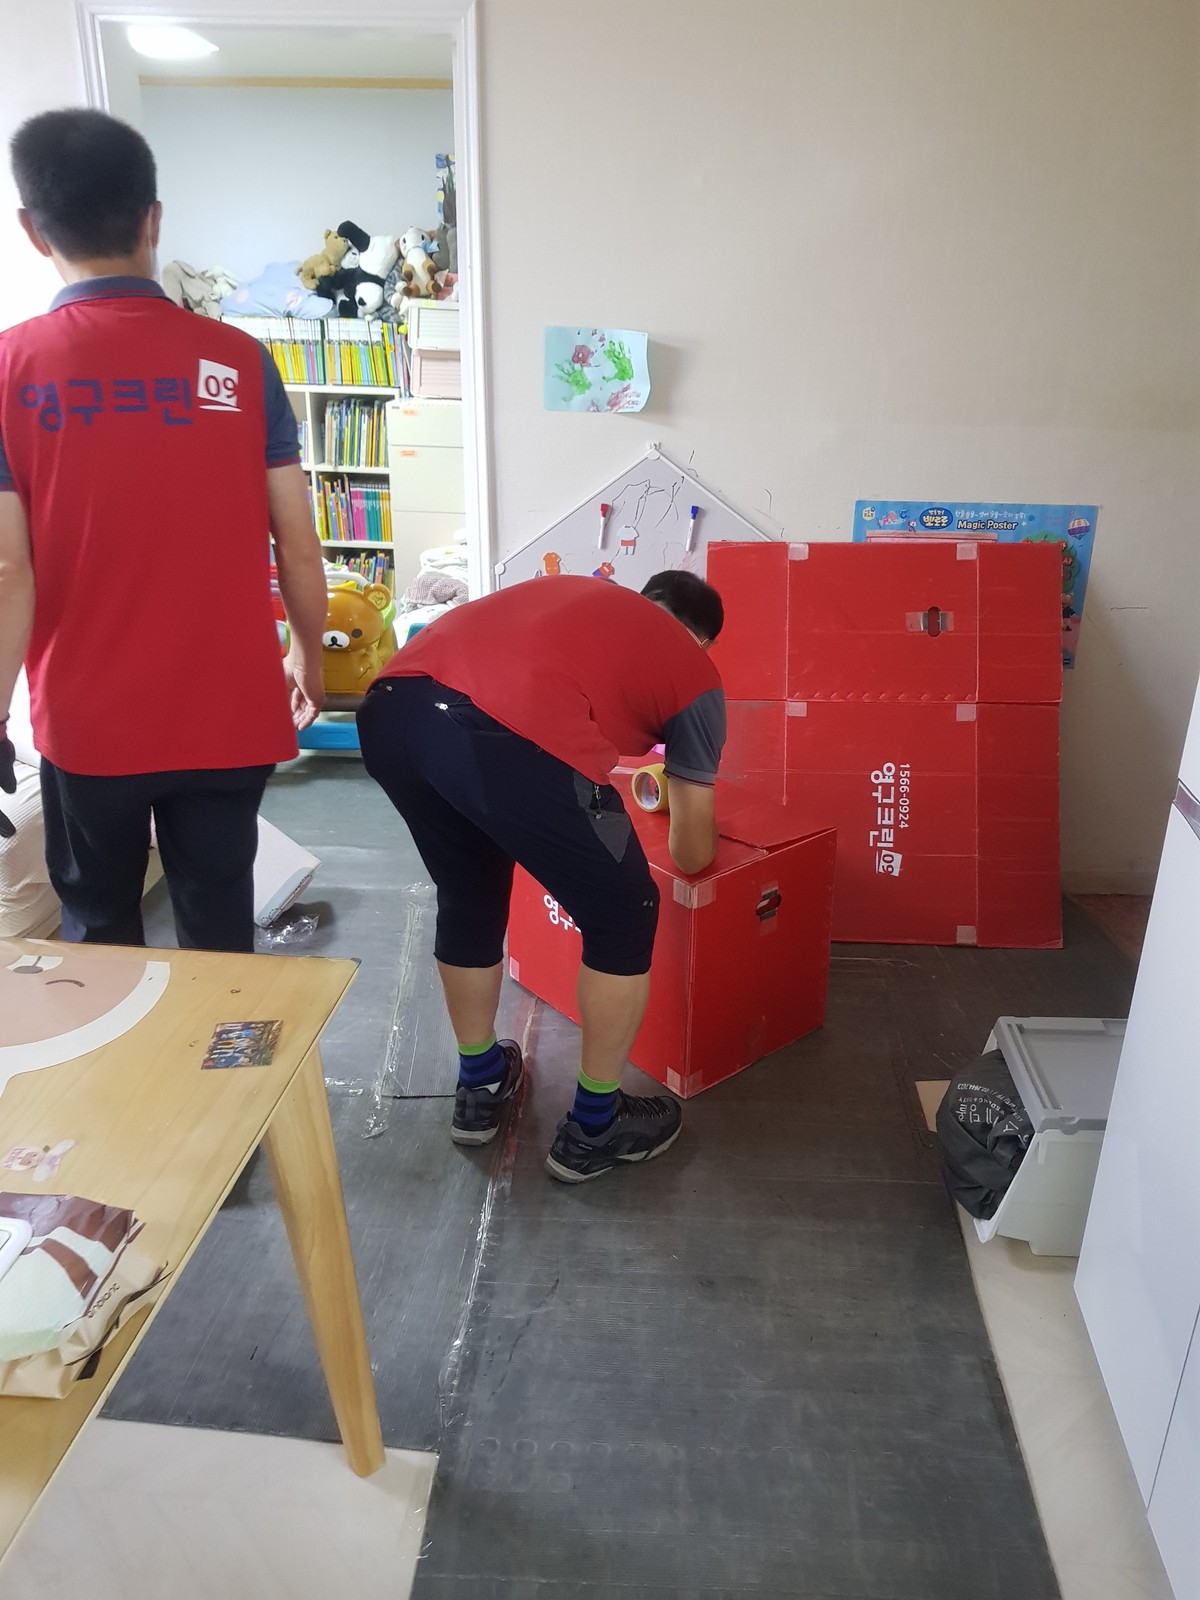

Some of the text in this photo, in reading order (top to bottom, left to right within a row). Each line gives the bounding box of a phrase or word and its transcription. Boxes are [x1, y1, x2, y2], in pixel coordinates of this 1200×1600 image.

[19, 372, 238, 432] 영구크린 09
[957, 519, 1018, 531] Magic Poster
[870, 762, 896, 847] 영구크린
[899, 763, 910, 829] 1566-0924
[543, 894, 582, 933] 영구
